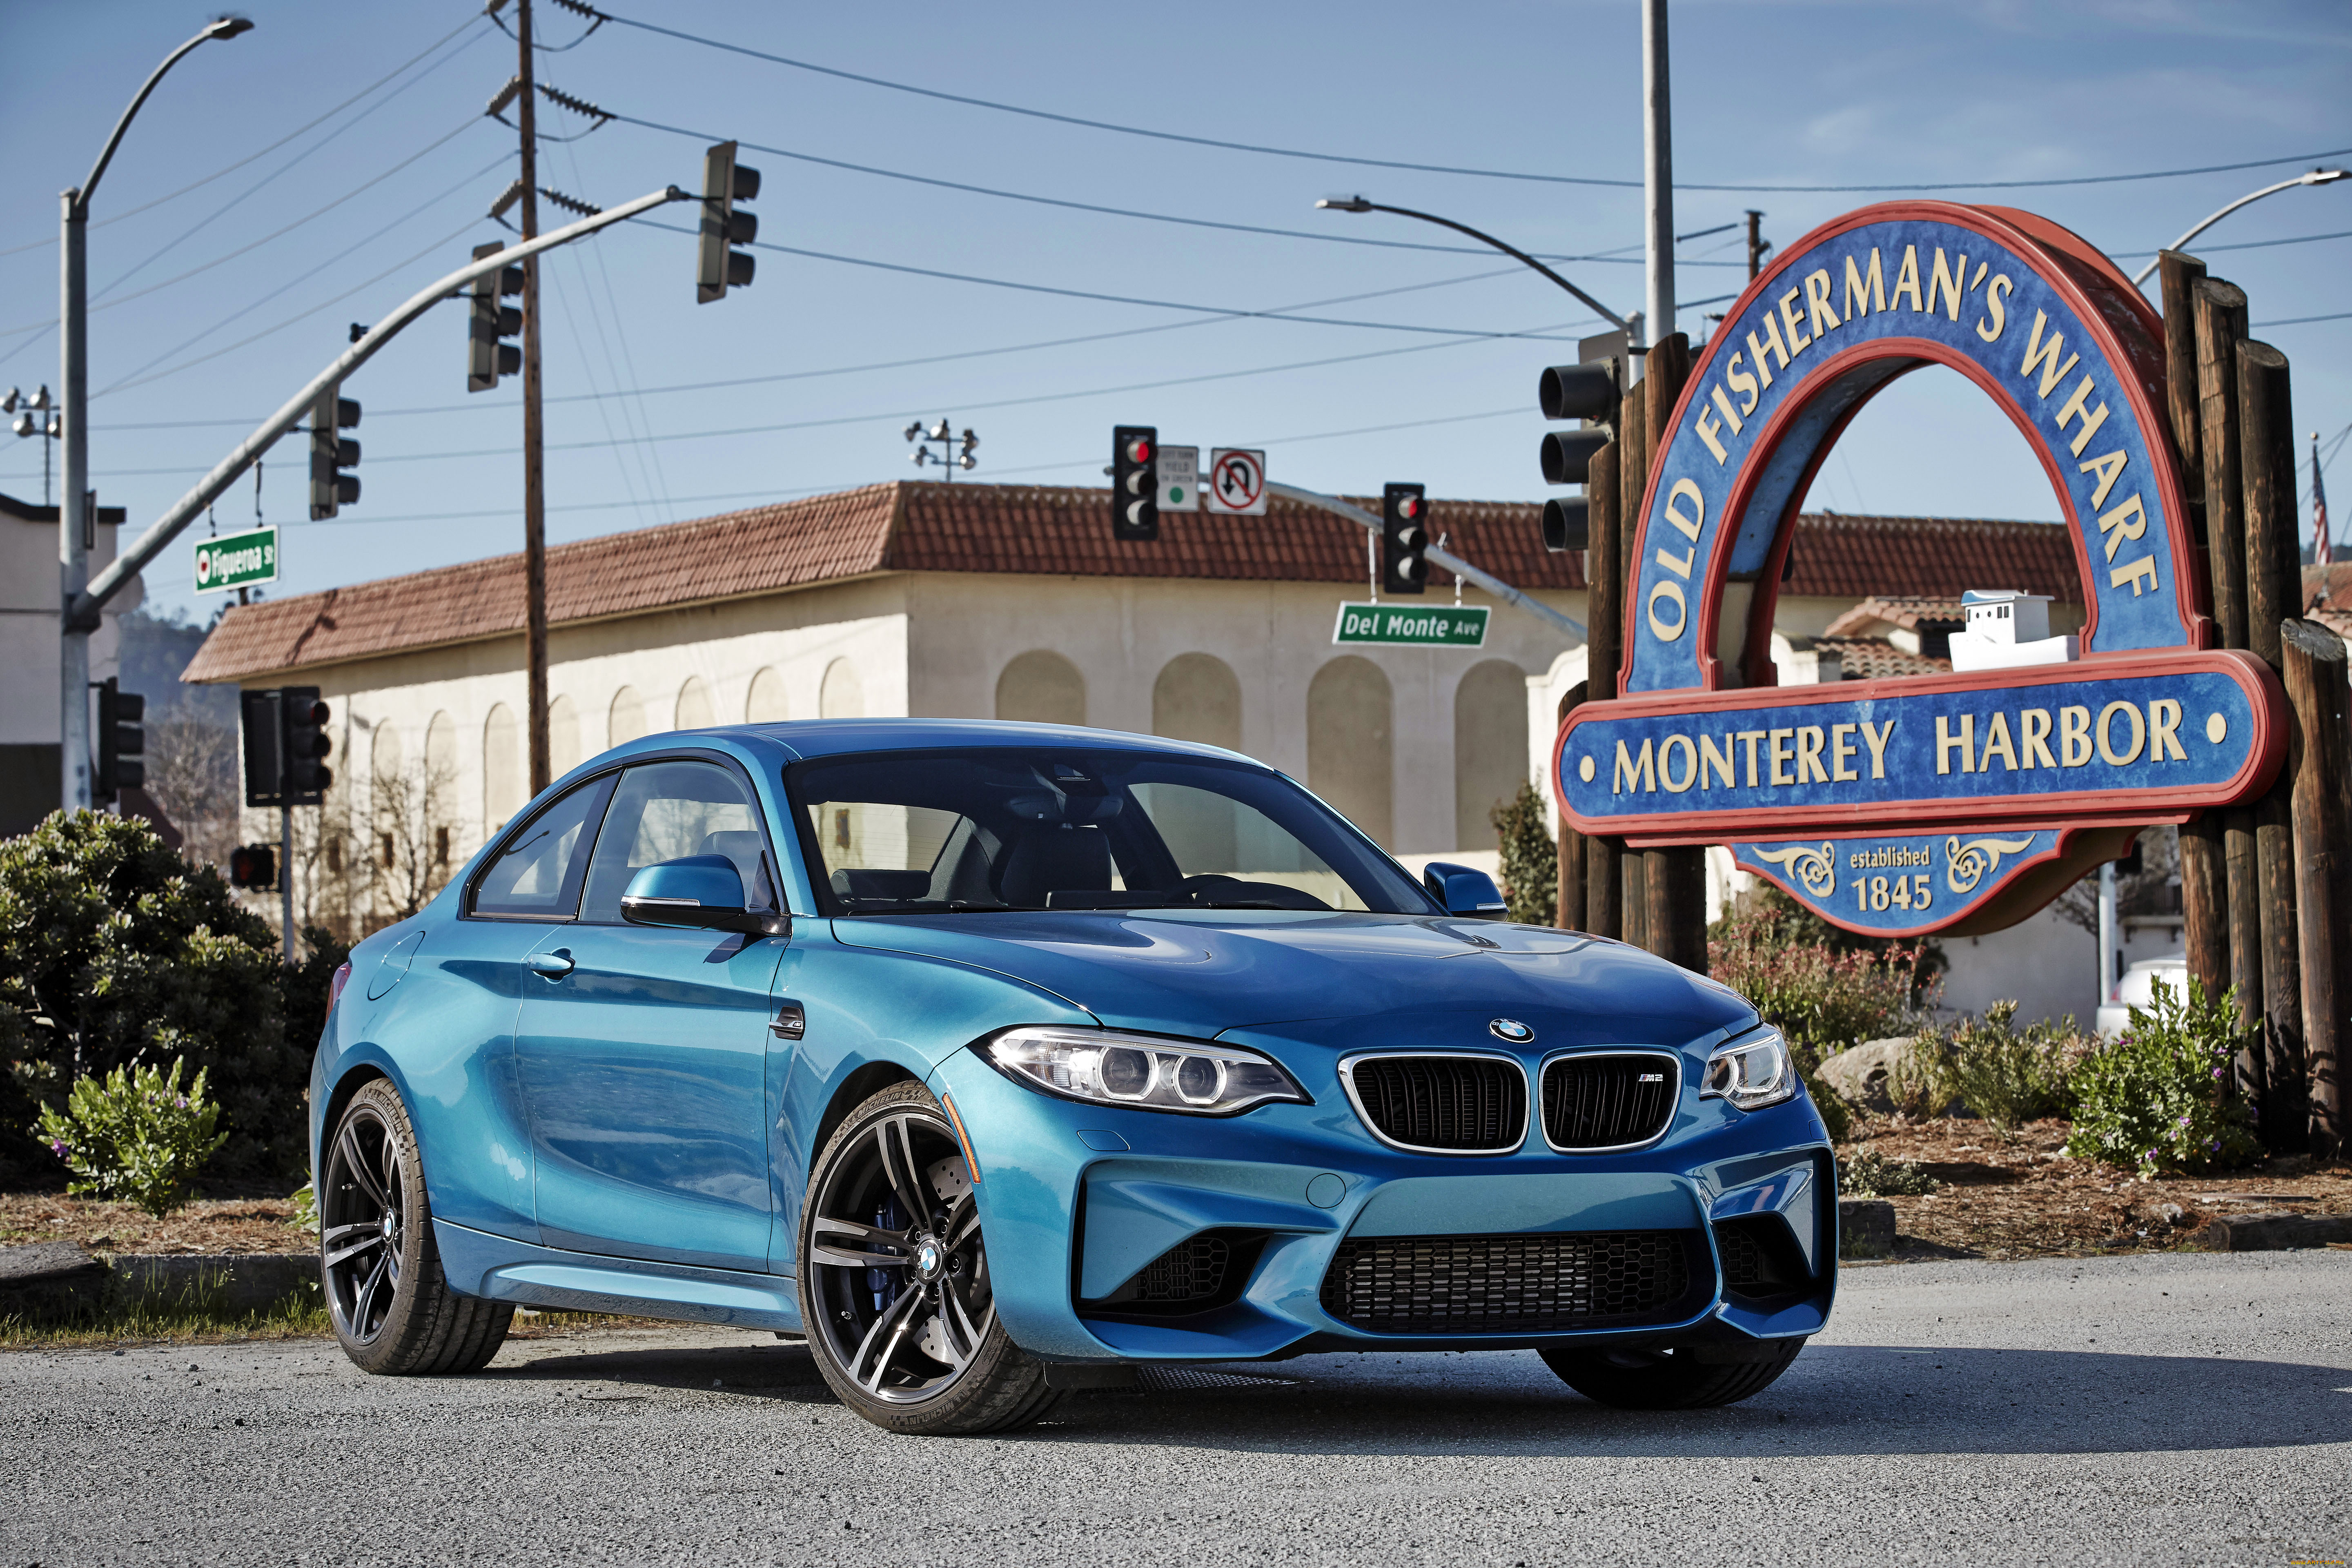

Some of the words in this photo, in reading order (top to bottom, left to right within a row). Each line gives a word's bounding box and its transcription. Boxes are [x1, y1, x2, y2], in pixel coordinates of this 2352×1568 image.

[1648, 478, 1704, 642] OLD
[1695, 244, 2013, 466] FISHERMAN'S
[2020, 308, 2158, 597] WHARF
[212, 546, 262, 584] Figueroa
[1345, 612, 1380, 635] Del
[1386, 615, 1449, 638] Monte
[1454, 620, 1480, 636] Ave
[1613, 720, 1895, 794] MONTEREY
[1936, 699, 2188, 775] HARBOR
[1850, 845, 1930, 869] established
[1851, 874, 1932, 911] 1845
[377, 1093, 404, 1132] MICHELIN
[858, 1091, 903, 1117] MICHELIN
[909, 1399, 955, 1425] MICHELIN
